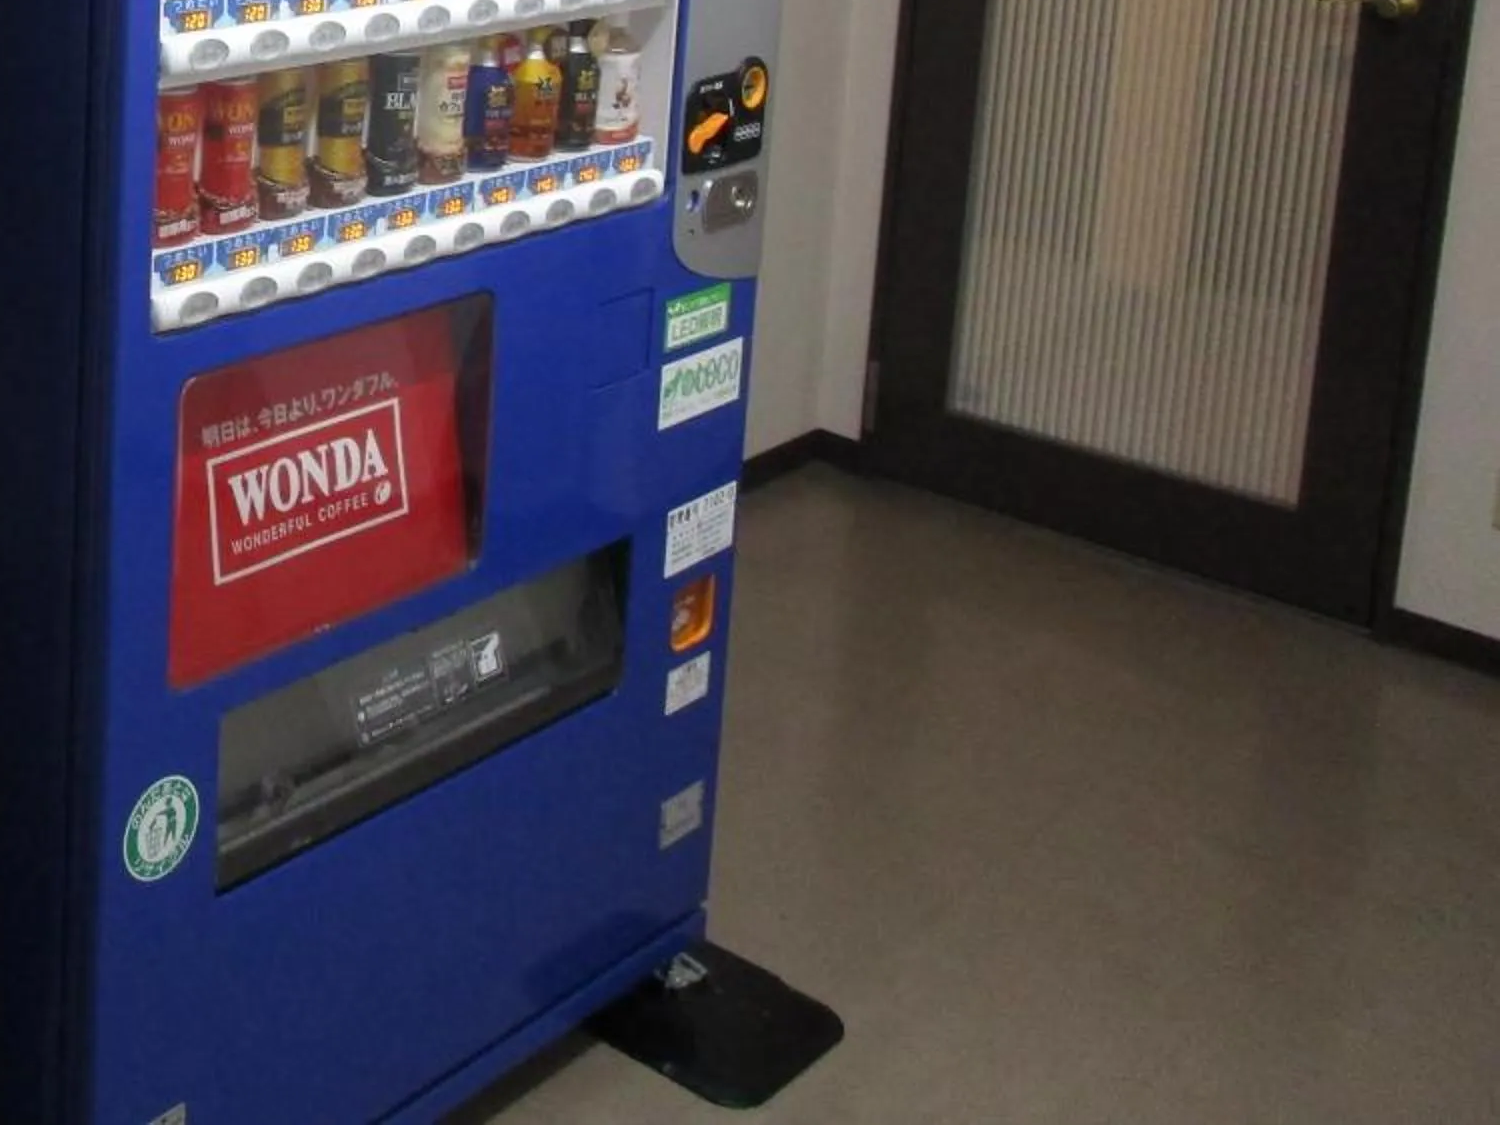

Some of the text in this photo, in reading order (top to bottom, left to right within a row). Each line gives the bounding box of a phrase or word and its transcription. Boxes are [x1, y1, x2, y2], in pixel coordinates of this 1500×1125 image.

[228, 428, 388, 526] WONDA
[231, 495, 368, 555] WONDERFUL COFFEE
